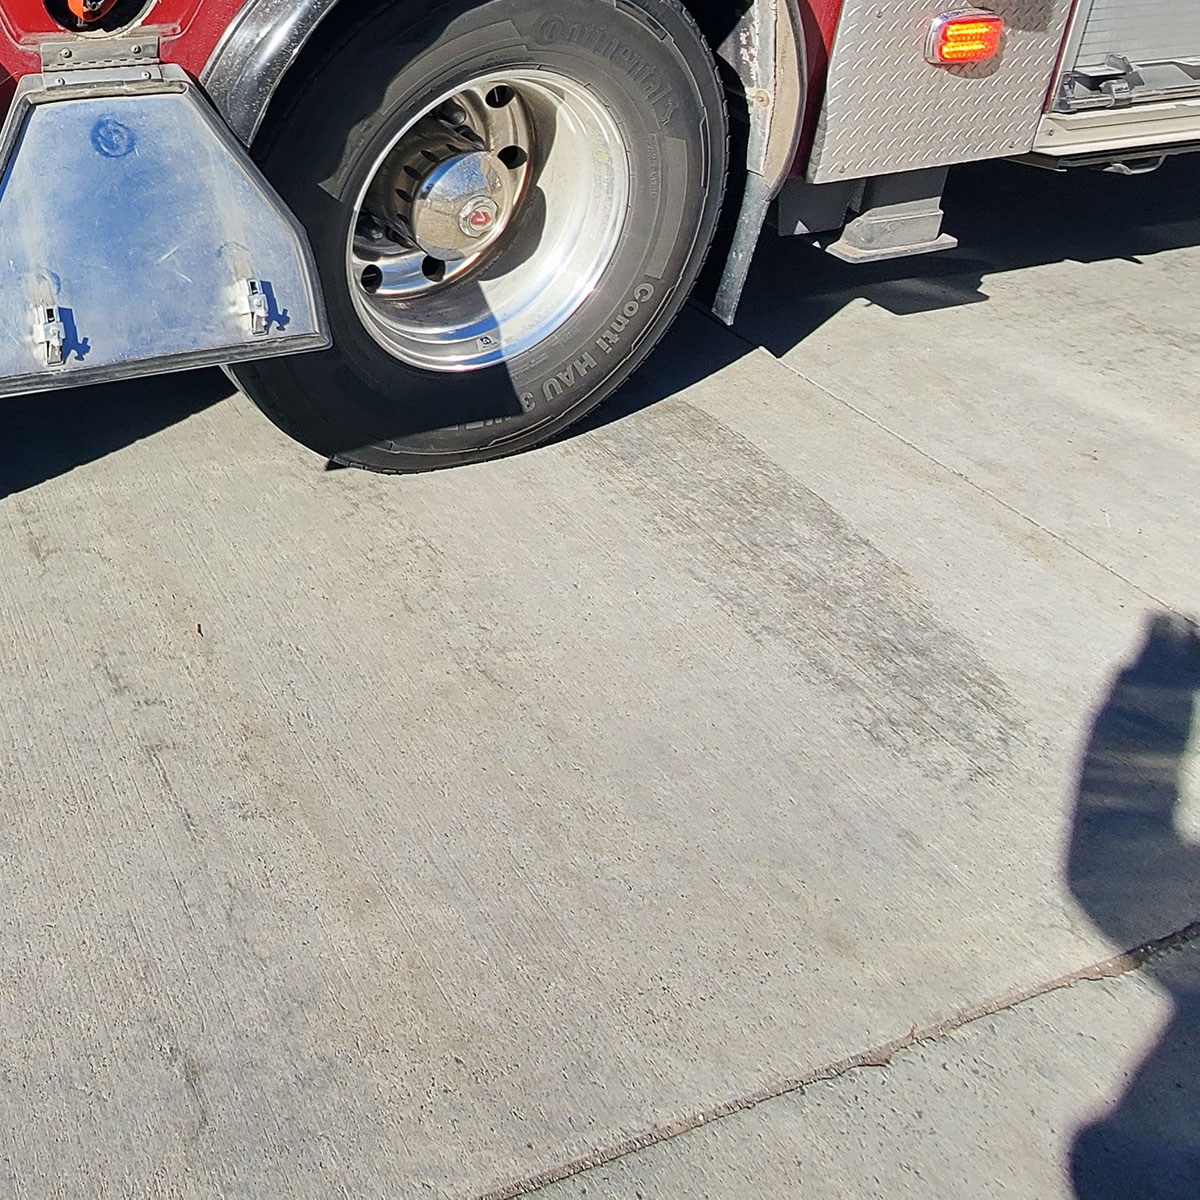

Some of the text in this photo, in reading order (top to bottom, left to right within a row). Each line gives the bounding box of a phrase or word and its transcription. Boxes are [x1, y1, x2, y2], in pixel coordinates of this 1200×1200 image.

[532, 14, 673, 106] Continental
[596, 283, 655, 354] Conti
[541, 352, 598, 401] HAU
